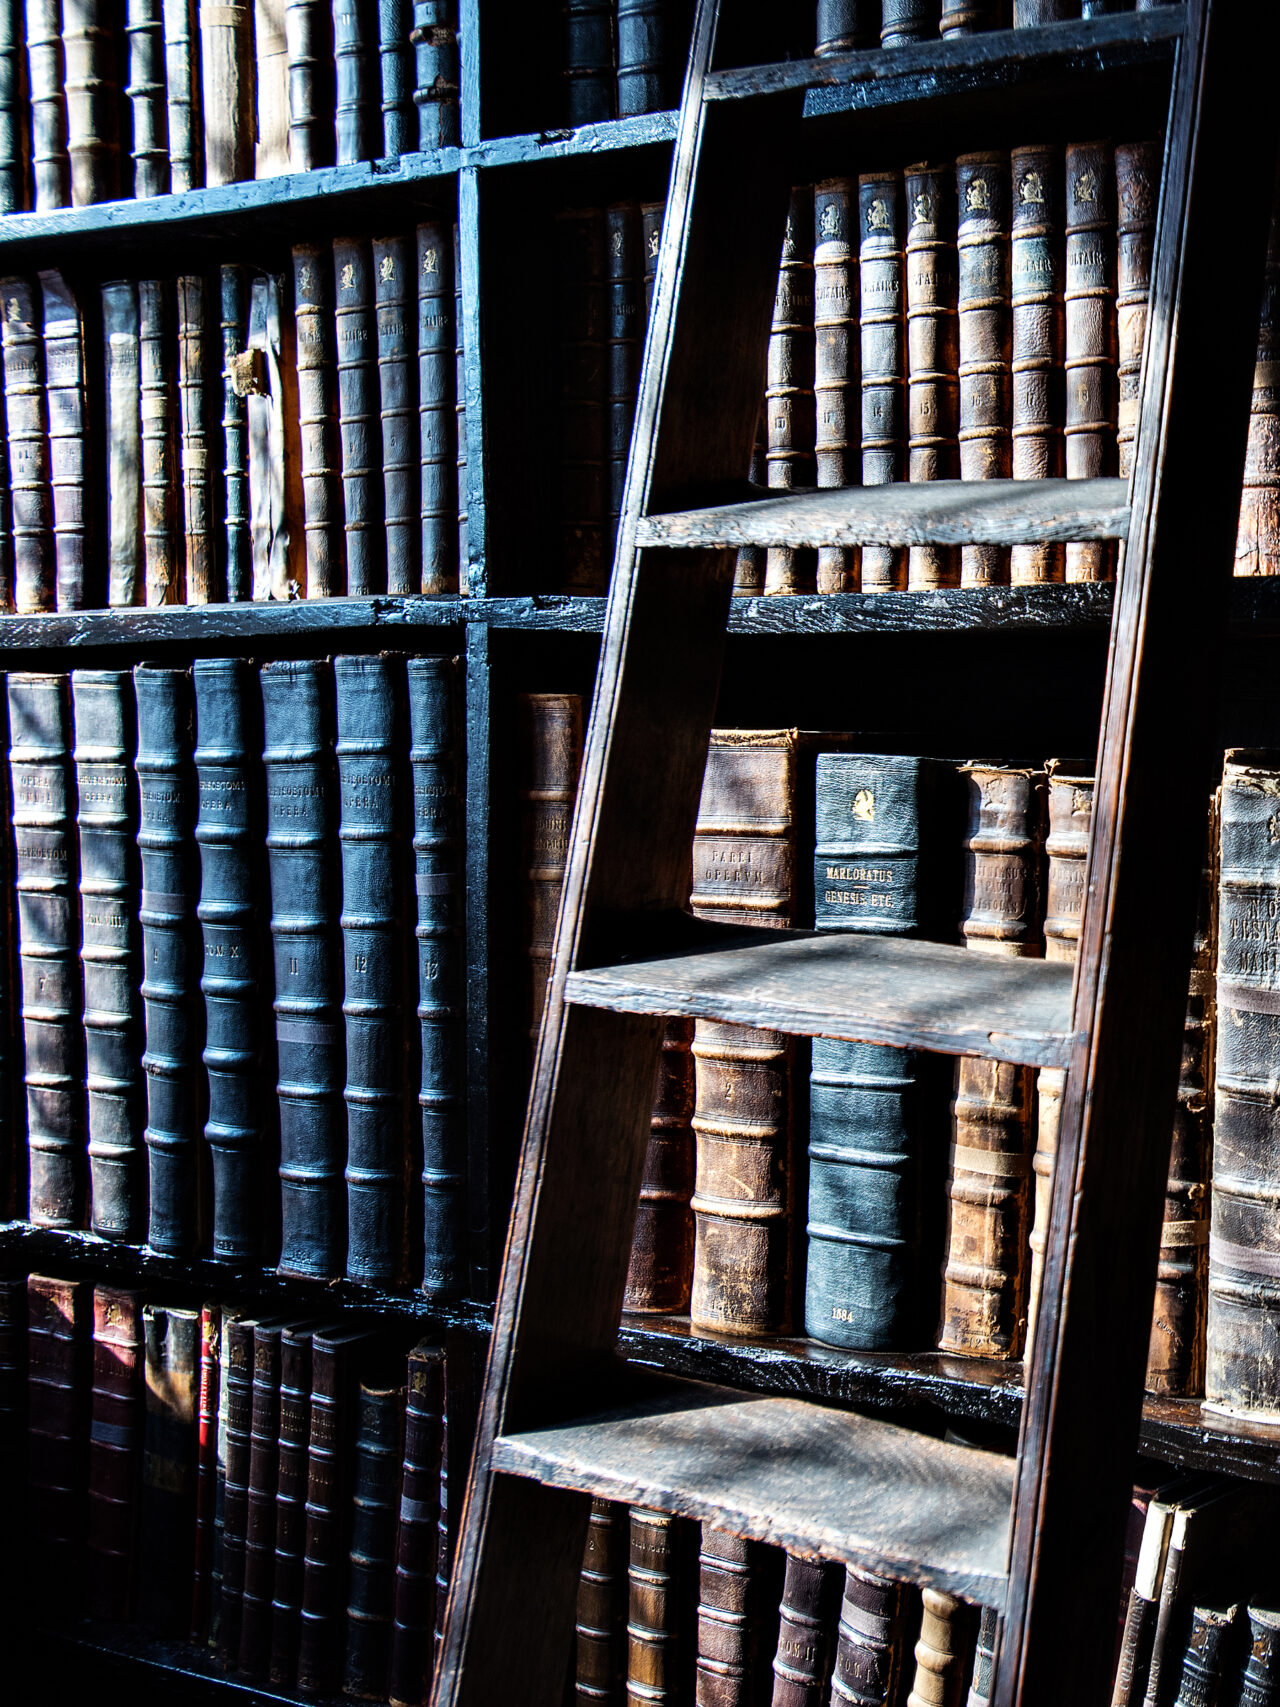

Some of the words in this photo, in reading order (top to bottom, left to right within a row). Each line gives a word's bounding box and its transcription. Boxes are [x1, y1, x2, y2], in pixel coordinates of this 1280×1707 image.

[920, 402, 931, 416] 15
[85, 792, 114, 802] OPERA
[201, 800, 233, 812] OPERA
[825, 866, 894, 884] MARLORATUS
[871, 893, 895, 909] ETC.
[354, 955, 368, 974] 12
[425, 961, 440, 981] 13
[724, 1081, 733, 1101] 2
[1119, 1595, 1146, 1691] COLLECTIONS
